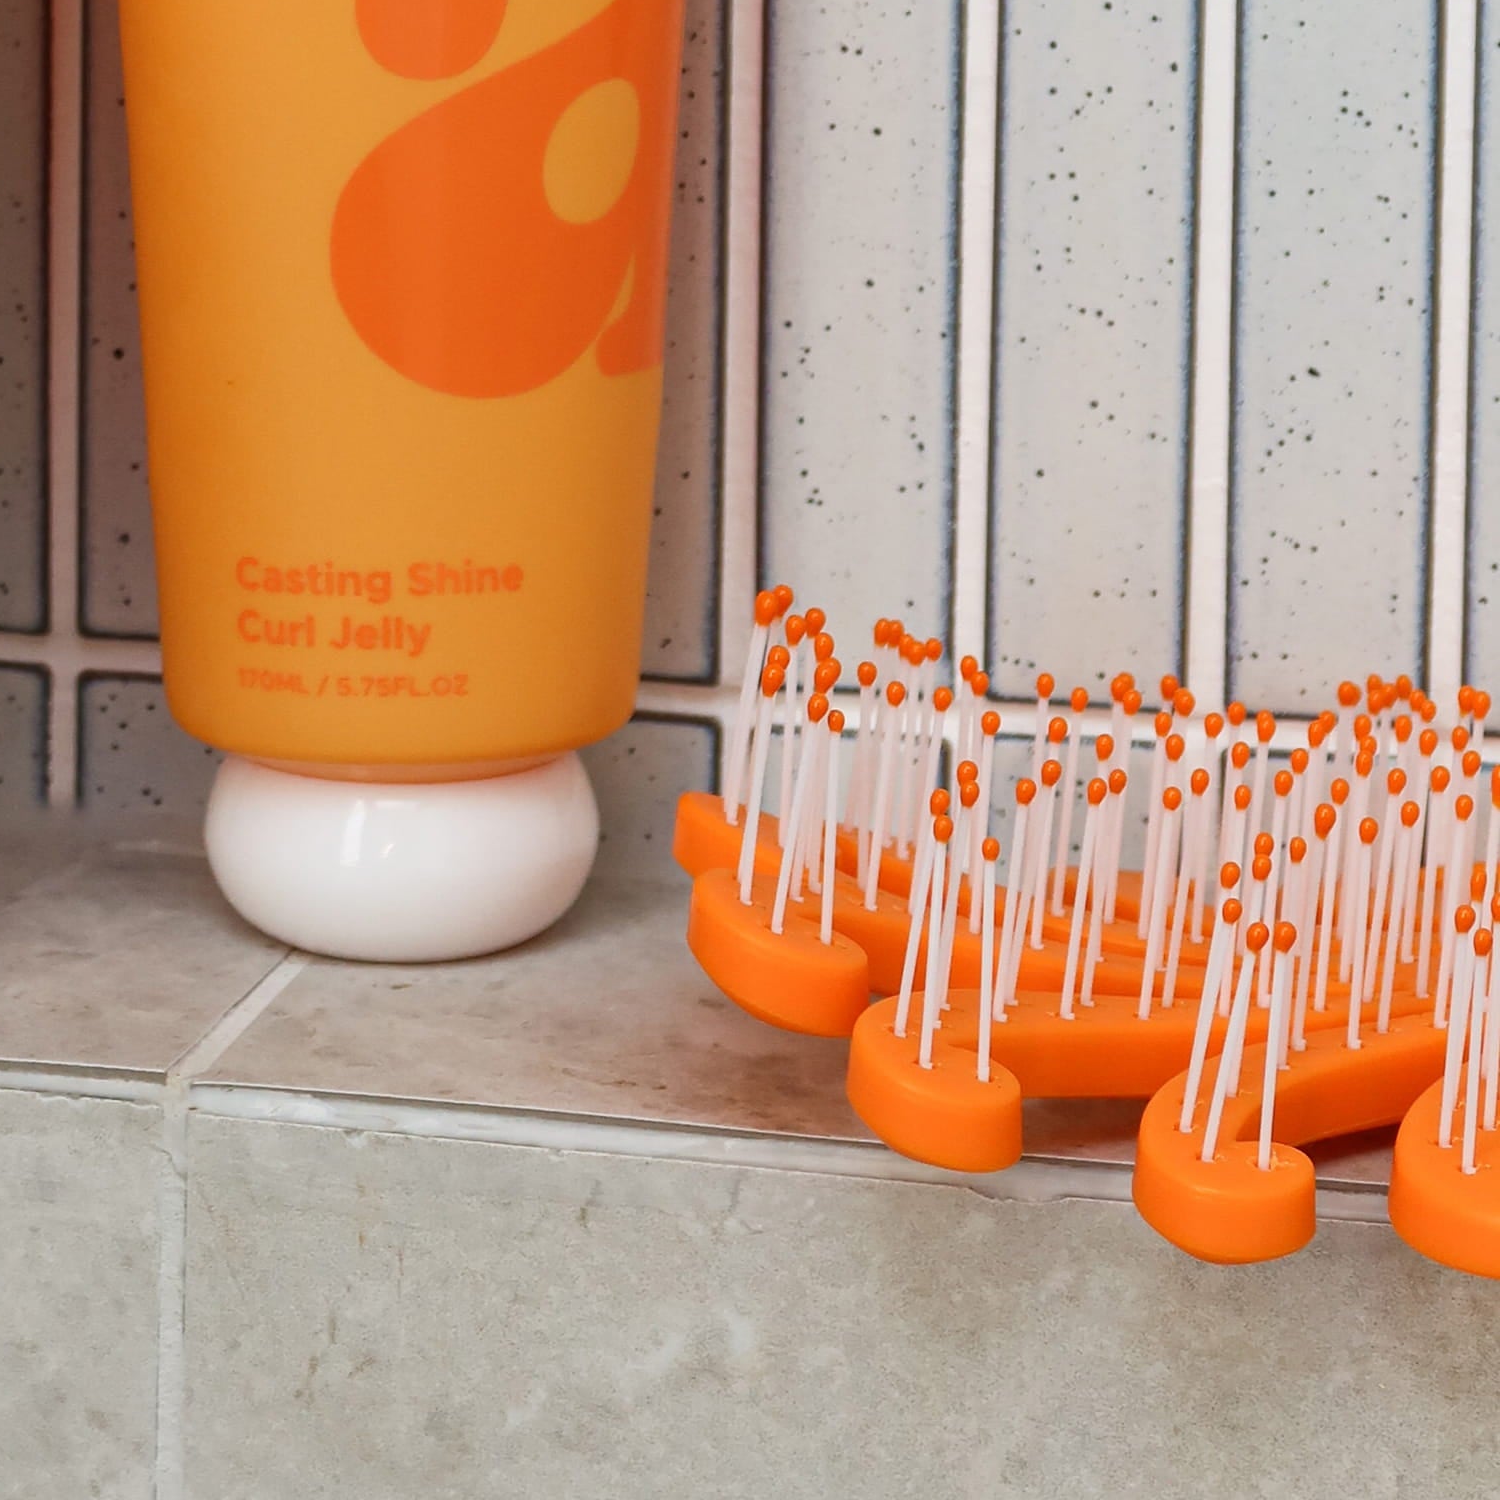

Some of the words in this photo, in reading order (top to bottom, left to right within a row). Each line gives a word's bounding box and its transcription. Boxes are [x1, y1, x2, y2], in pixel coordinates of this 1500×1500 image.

[236, 556, 393, 605] Casting
[407, 559, 525, 596] Shine
[237, 609, 316, 648] Curl
[329, 615, 433, 658] Jelly
